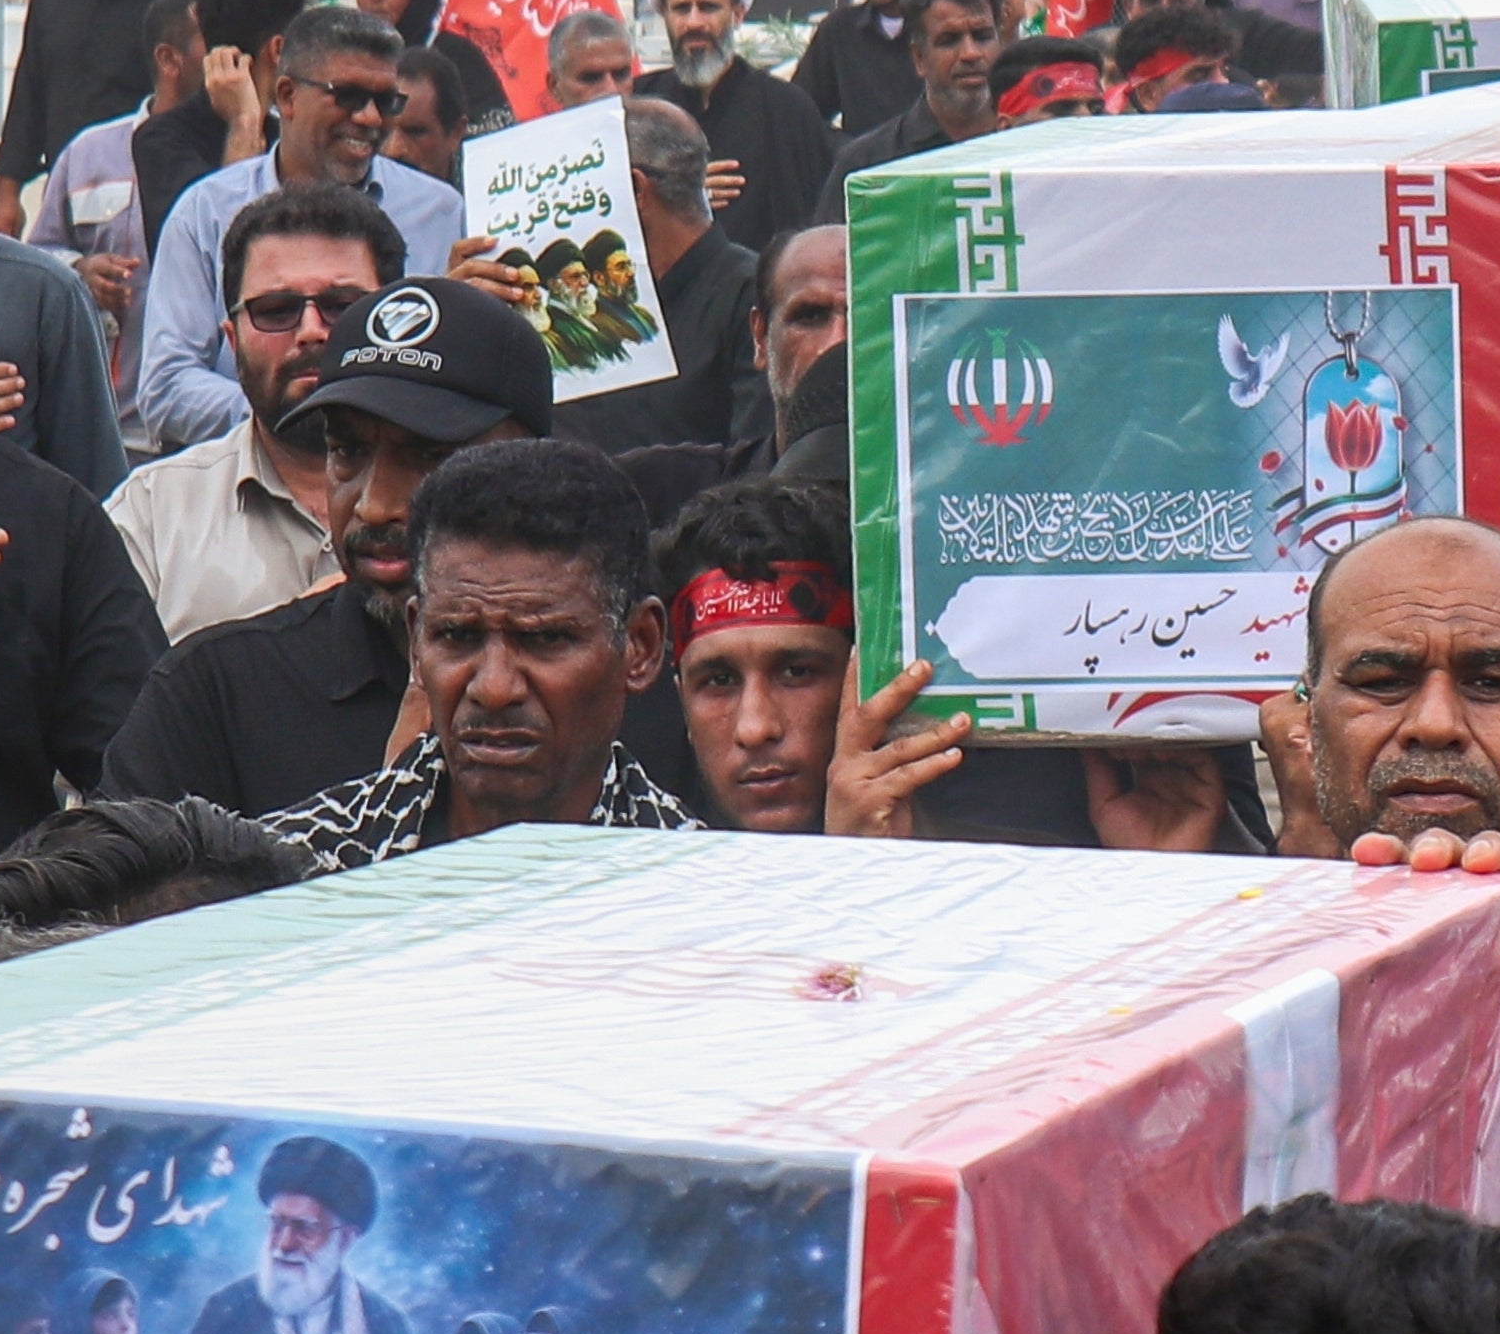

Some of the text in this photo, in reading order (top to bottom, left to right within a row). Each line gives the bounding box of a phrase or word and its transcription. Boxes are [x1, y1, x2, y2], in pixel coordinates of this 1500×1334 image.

[340, 347, 442, 371] FOTON
[1151, 585, 1238, 659] حسین
[3, 1107, 93, 1252] شجره
[85, 1143, 236, 1244] شهدای
